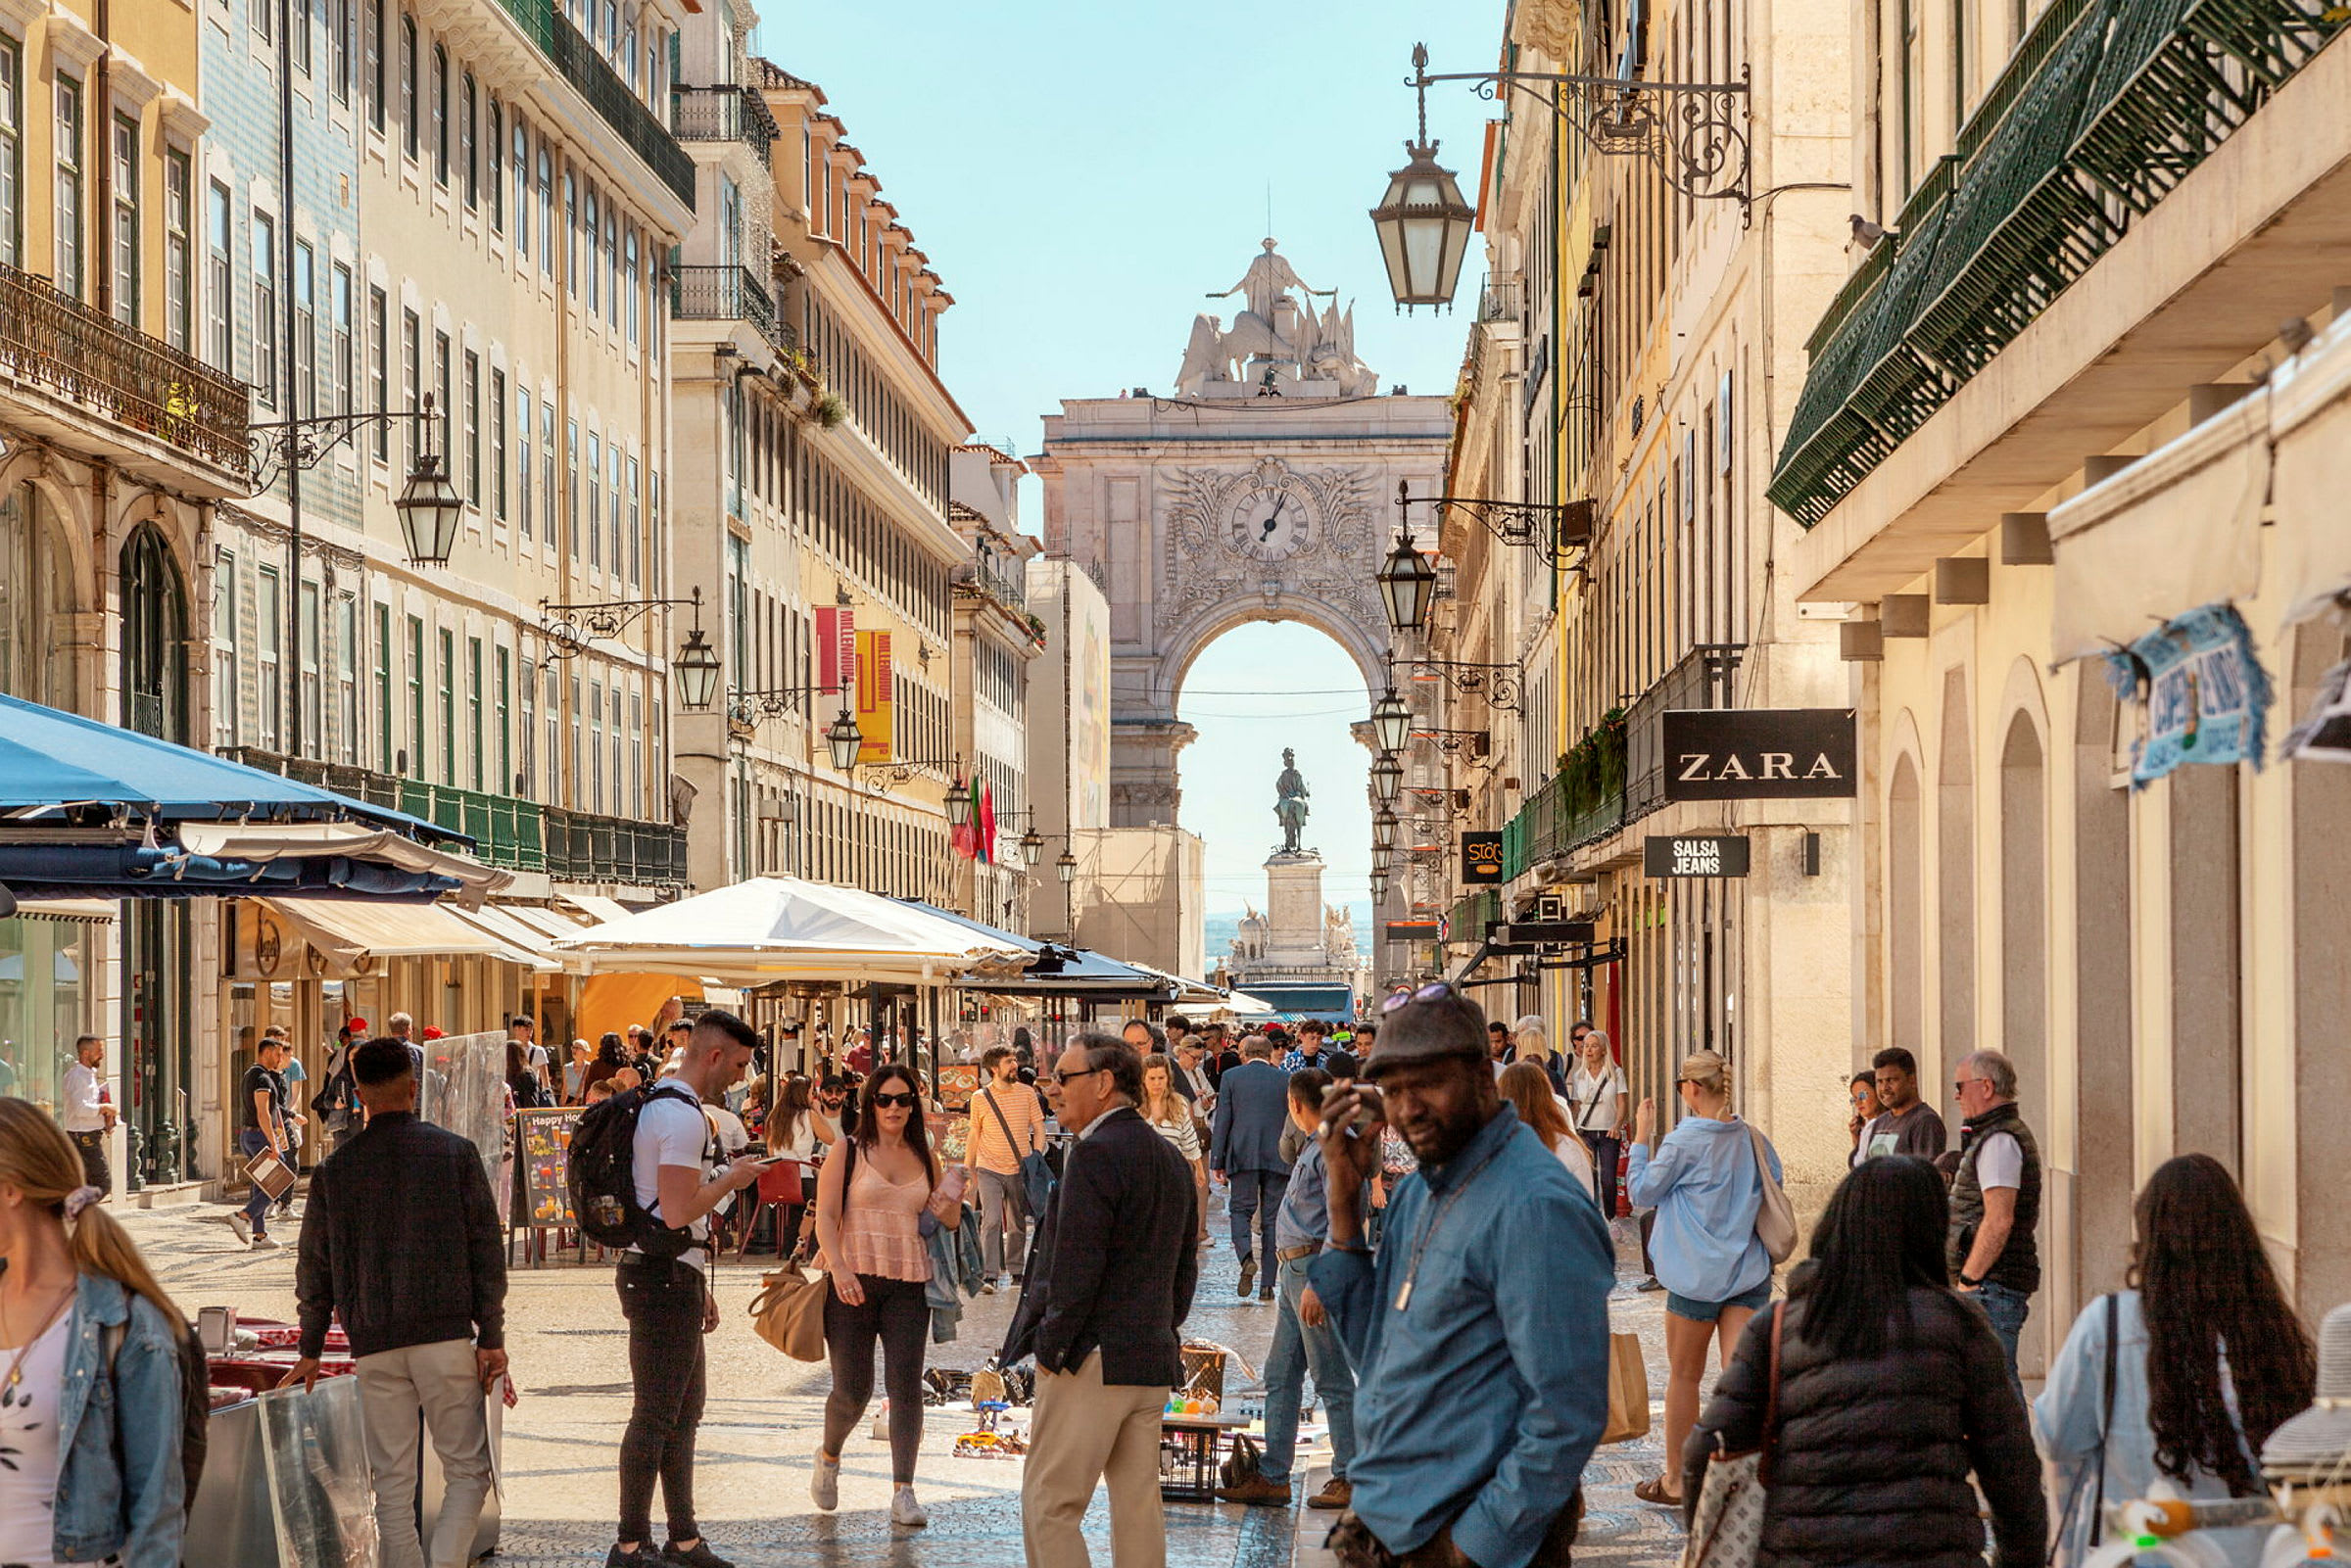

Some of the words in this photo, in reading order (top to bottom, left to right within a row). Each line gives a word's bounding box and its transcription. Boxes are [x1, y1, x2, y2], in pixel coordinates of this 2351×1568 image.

[879, 635, 891, 701] MILLENNIUM
[1678, 752, 1843, 782] ZARA
[1672, 840, 1720, 858] SALSA
[1671, 857, 1720, 876] JEANS
[532, 1117, 563, 1126] Happy
[564, 1113, 580, 1122] Ho
